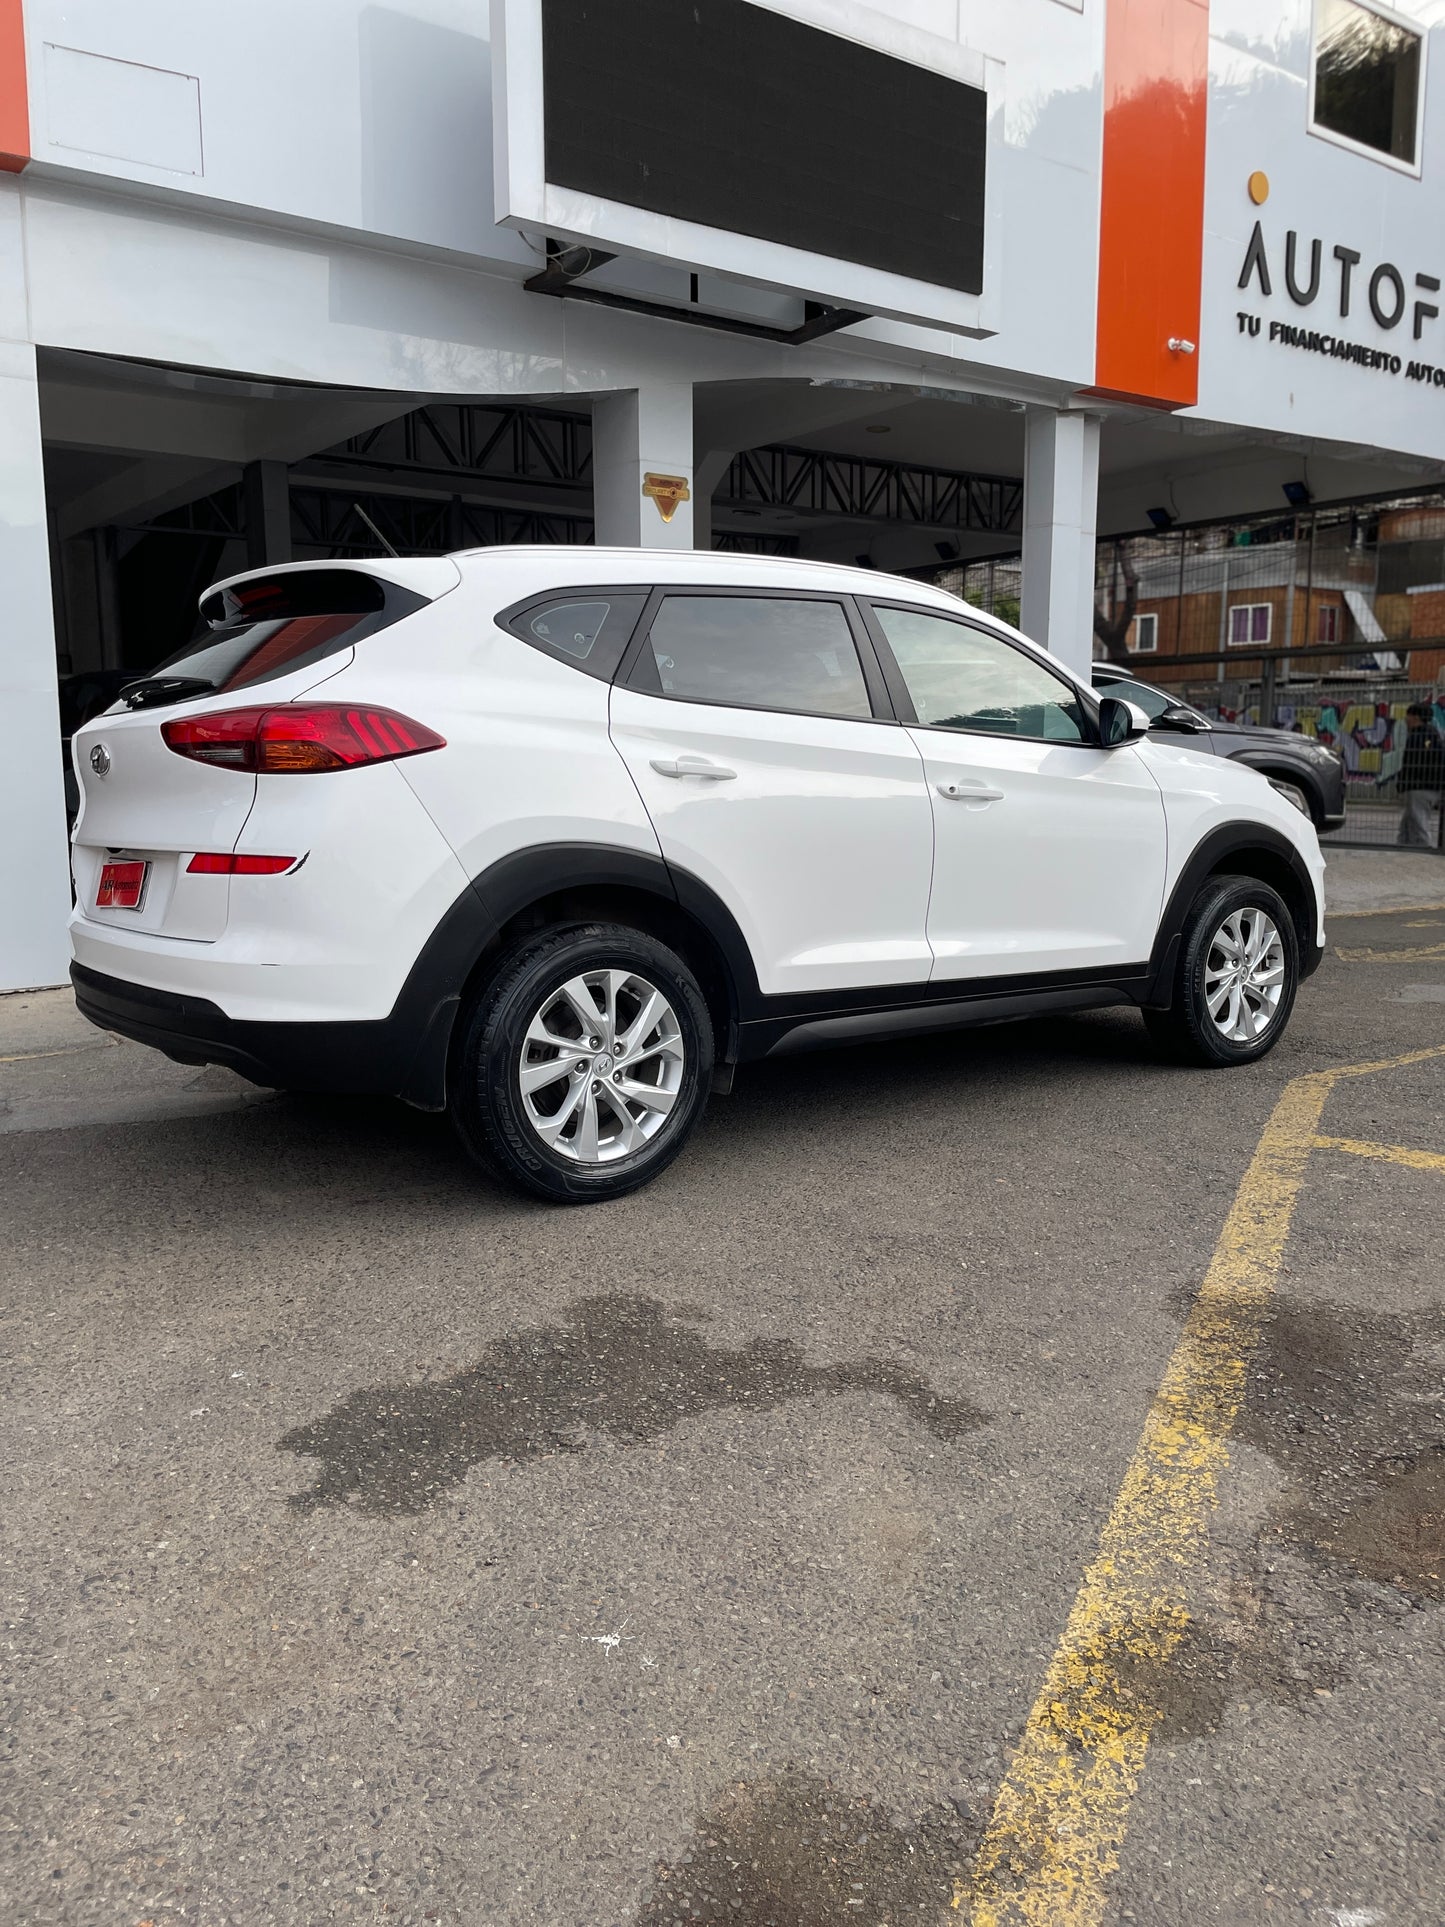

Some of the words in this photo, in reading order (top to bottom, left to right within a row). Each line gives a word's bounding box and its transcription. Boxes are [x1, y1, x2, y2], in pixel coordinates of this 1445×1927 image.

[1237, 312, 1261, 337] TU
[1270, 321, 1401, 374] FINANCIAMIENTO
[1405, 361, 1445, 388] AUTO
[494, 1085, 543, 1171] CRUGEN
